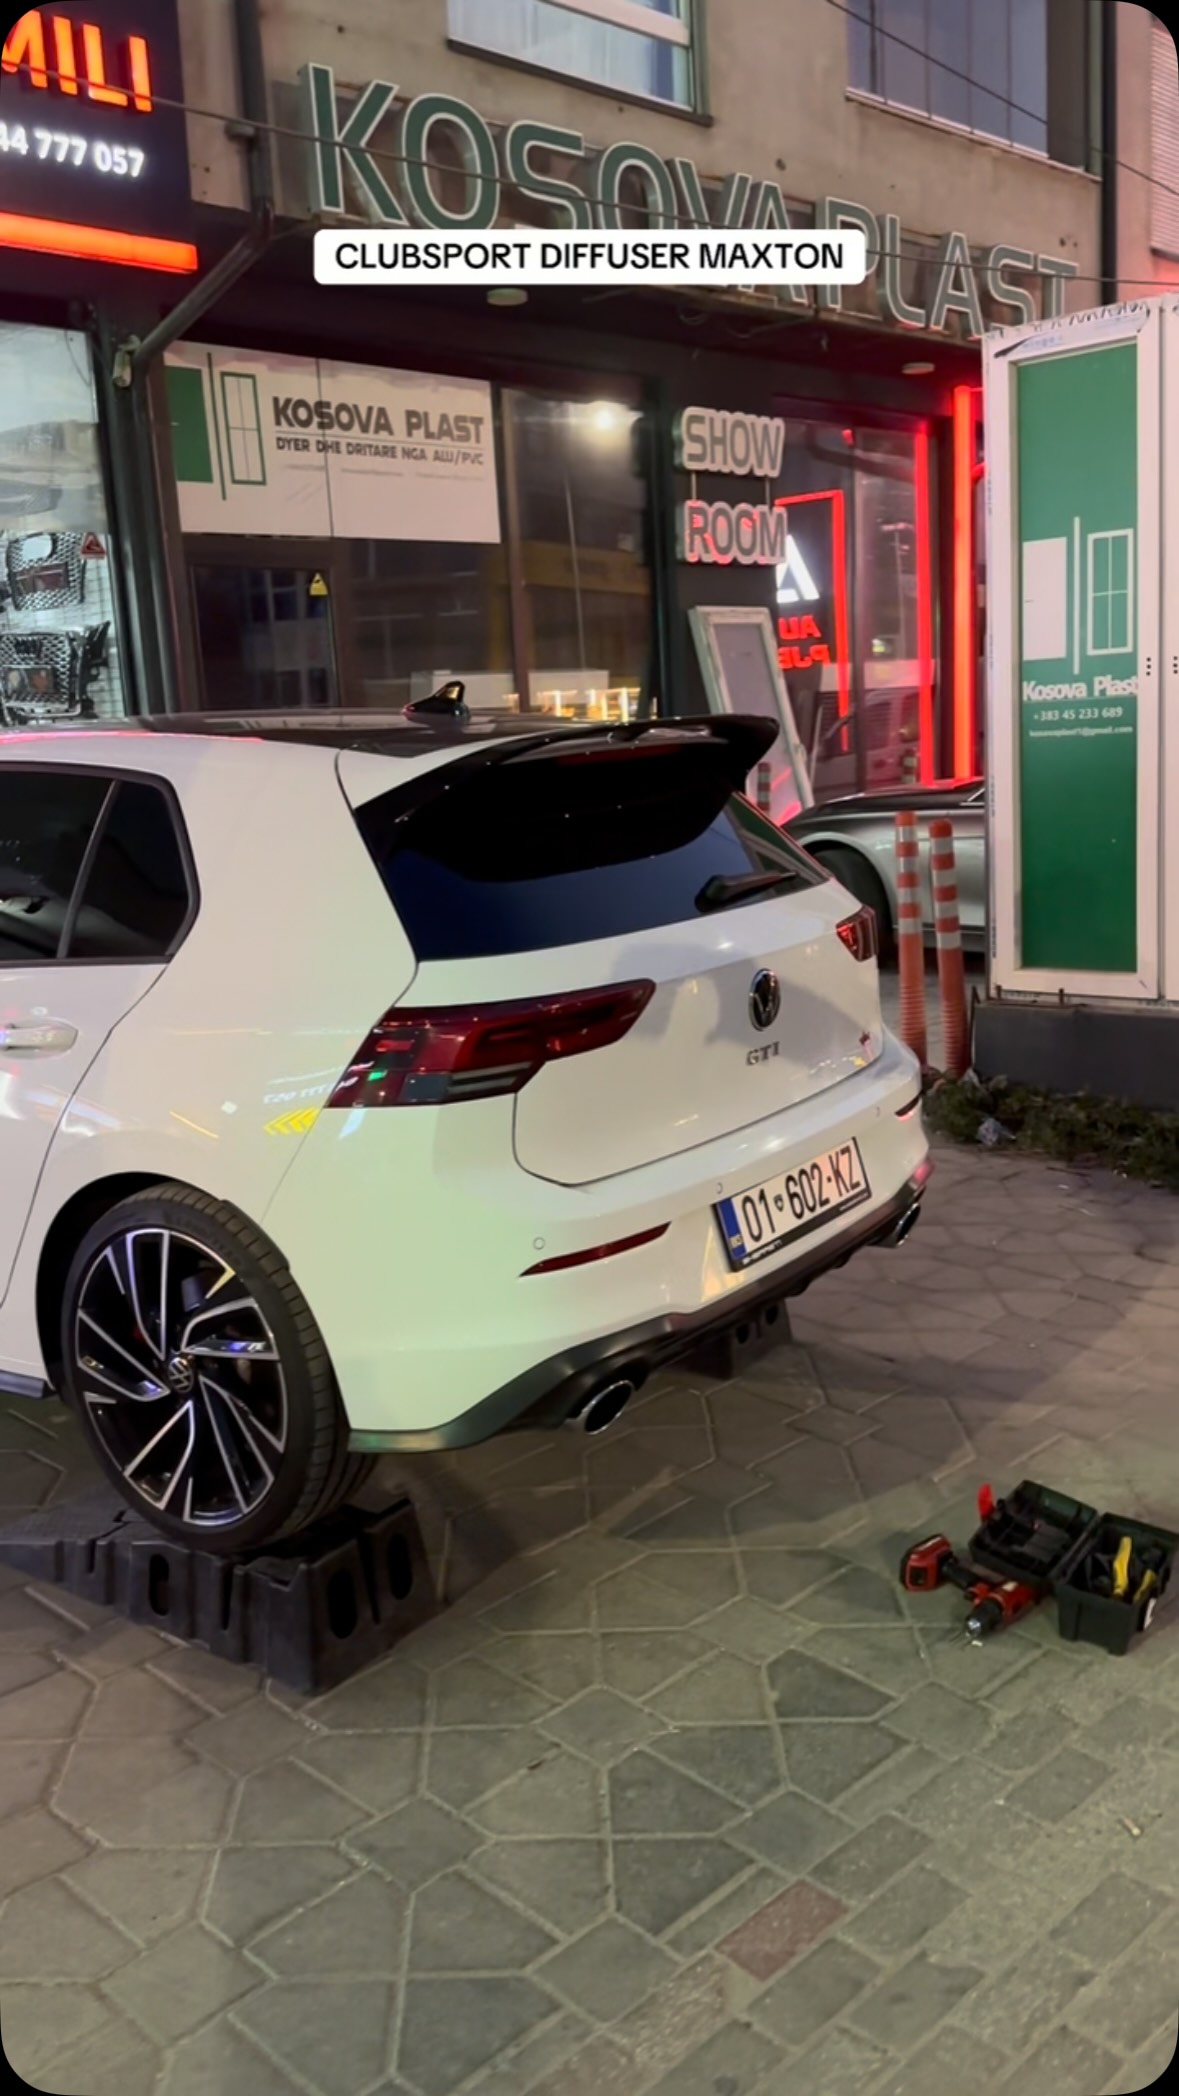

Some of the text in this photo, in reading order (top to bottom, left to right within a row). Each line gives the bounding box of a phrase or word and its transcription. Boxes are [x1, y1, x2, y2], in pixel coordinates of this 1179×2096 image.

[33, 127, 88, 167] 777
[93, 140, 145, 178] 057
[304, 62, 1079, 339] KOSOVA PLAST
[272, 396, 484, 444] KOSOVA PLAST
[684, 413, 782, 472] SHOW
[276, 436, 310, 453] DYER
[316, 439, 342, 455] DHE
[346, 442, 398, 459] DRITARE
[402, 448, 427, 461] NGA
[687, 505, 785, 560] ROOM
[1023, 675, 1138, 701] Kosova Plast
[1034, 707, 1123, 721] +383 45 233 689
[747, 1041, 780, 1066] GTI
